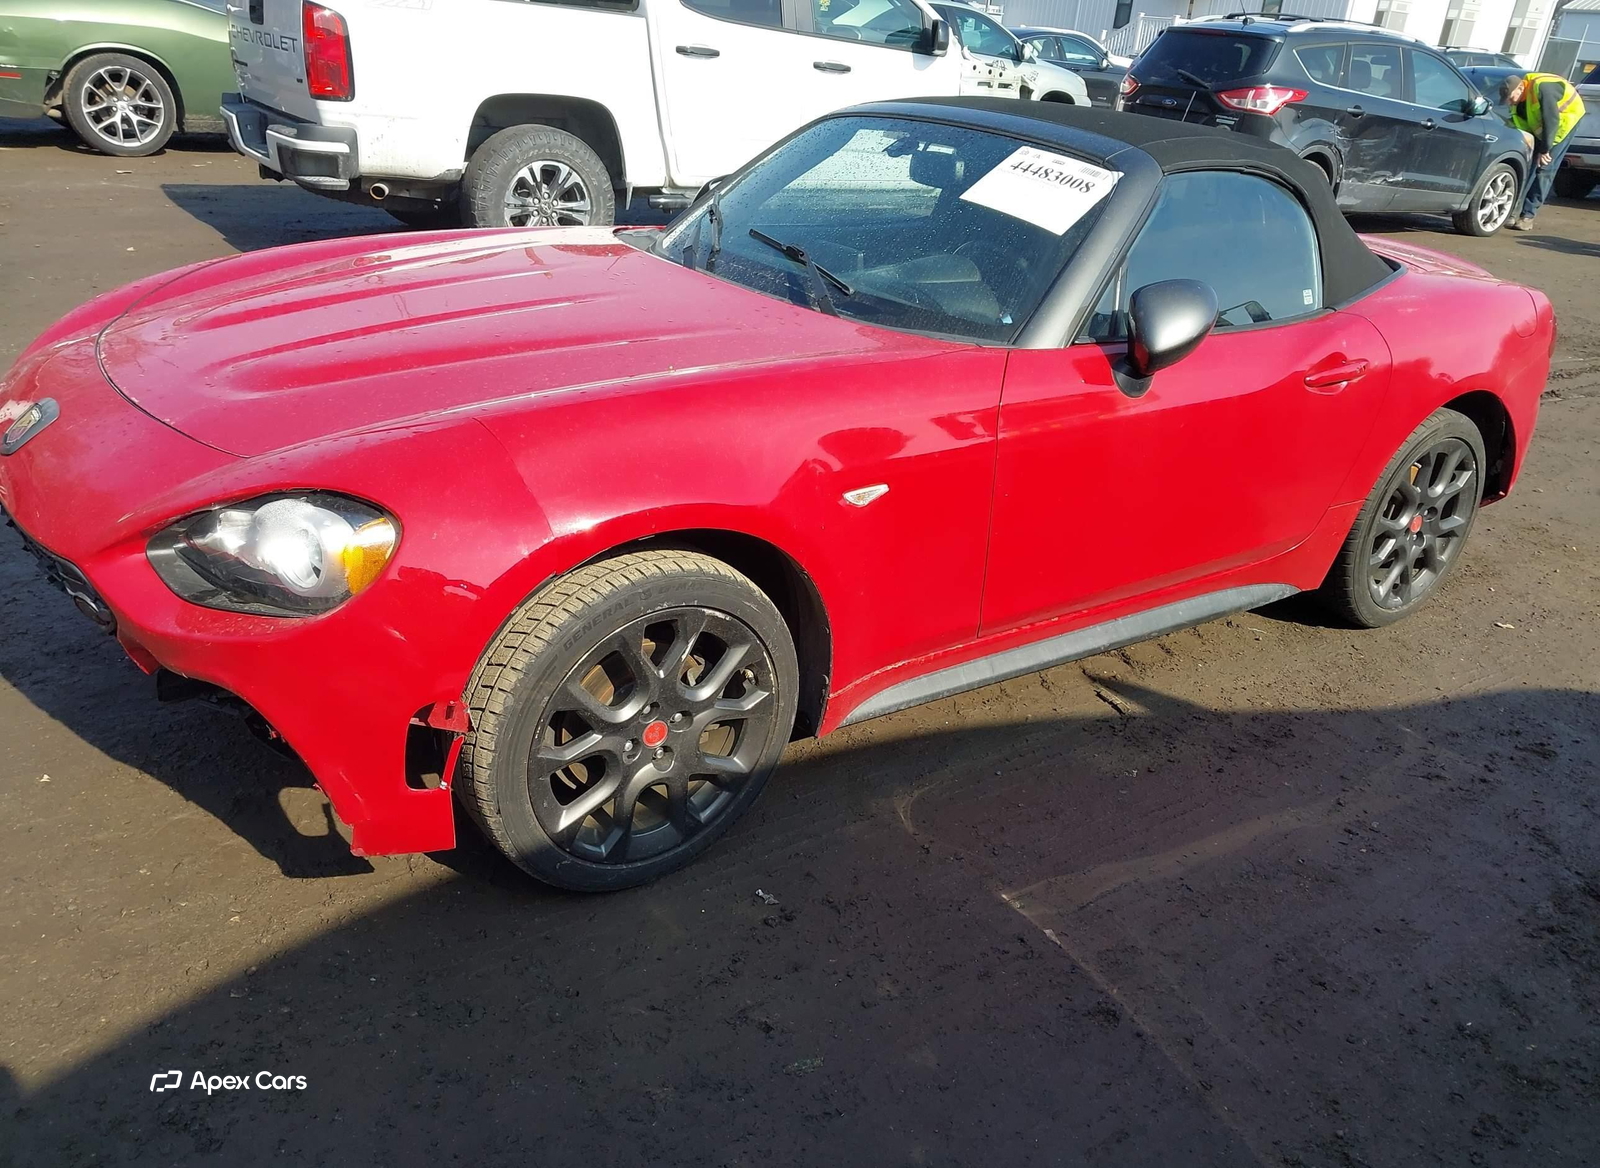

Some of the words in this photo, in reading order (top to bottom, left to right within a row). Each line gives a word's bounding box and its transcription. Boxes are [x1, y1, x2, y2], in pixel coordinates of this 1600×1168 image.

[230, 24, 298, 53] CHEVROLET
[1010, 160, 1096, 193] 44483008
[563, 599, 636, 651] GENERAL
